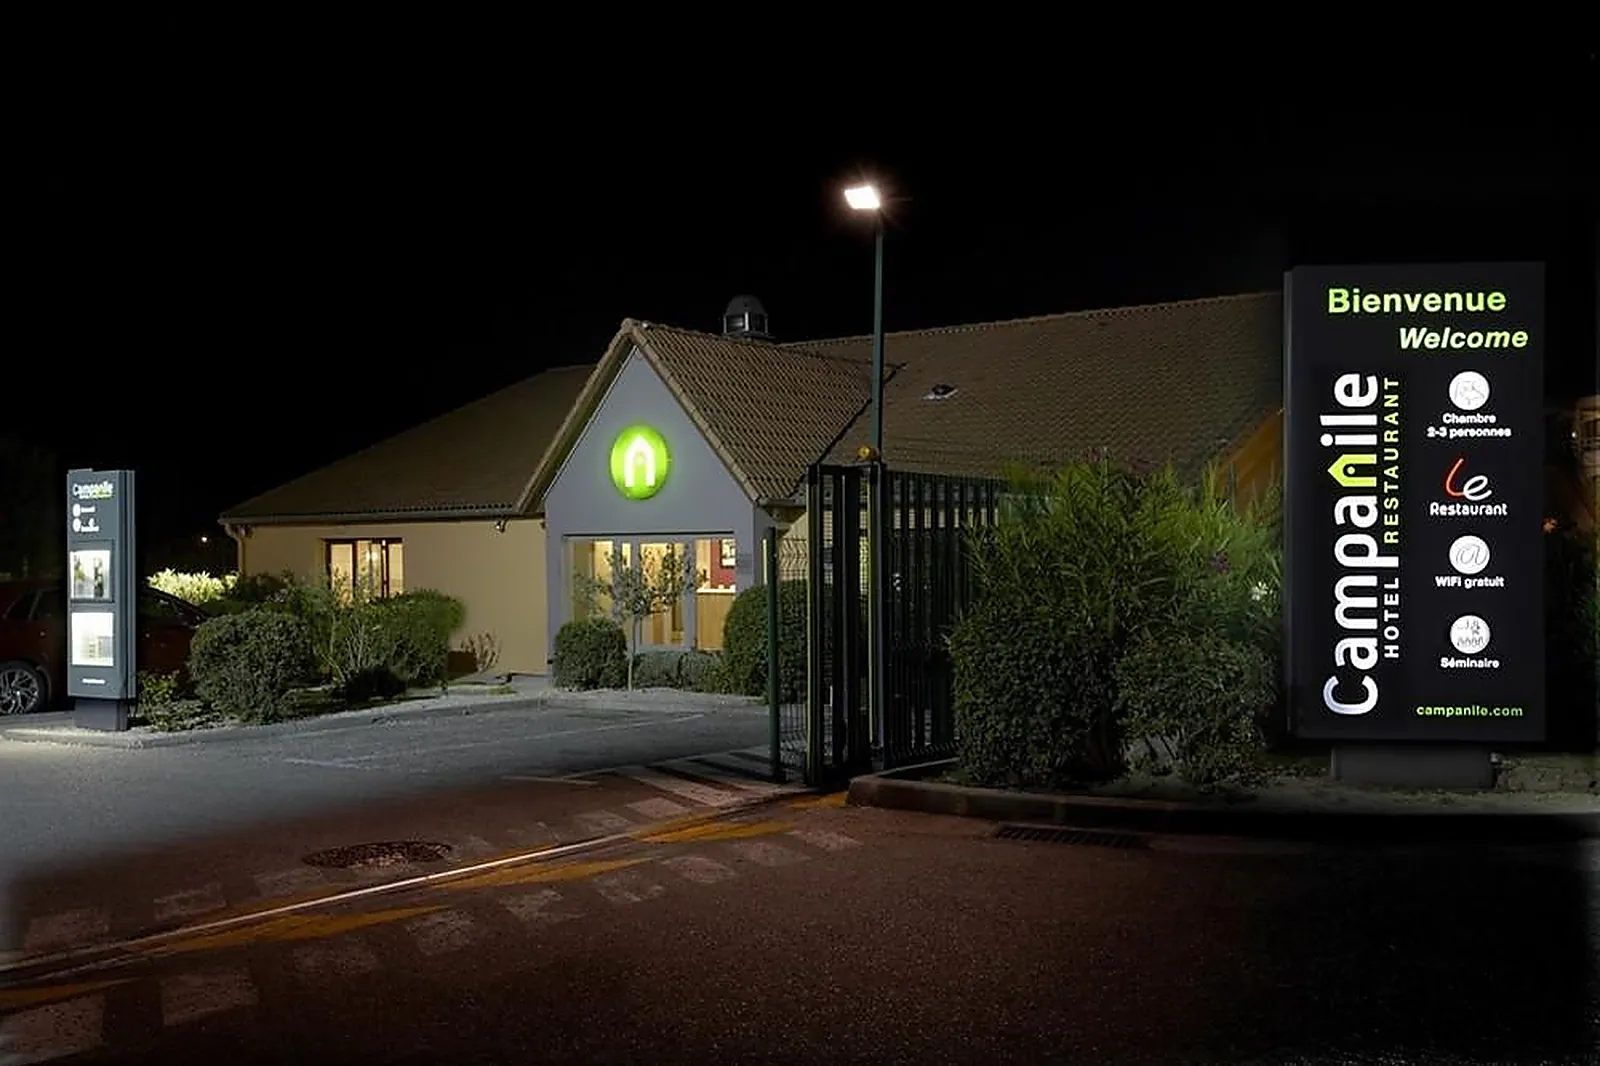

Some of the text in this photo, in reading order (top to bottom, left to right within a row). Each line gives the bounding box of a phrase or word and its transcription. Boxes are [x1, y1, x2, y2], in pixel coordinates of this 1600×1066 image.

[1328, 288, 1507, 313] Bienvenue
[1399, 327, 1529, 349] Welcome
[1443, 413, 1496, 424] Chambre
[1427, 427, 1512, 438] 2-3 personnes
[1430, 502, 1508, 516] Restaurant
[1384, 378, 1399, 658] HOTEL RESTAURANT
[1320, 373, 1399, 715] Campanile
[1464, 576, 1505, 589] gratuit
[1440, 656, 1500, 669] Séminaire
[1416, 704, 1523, 718] campanile.com
